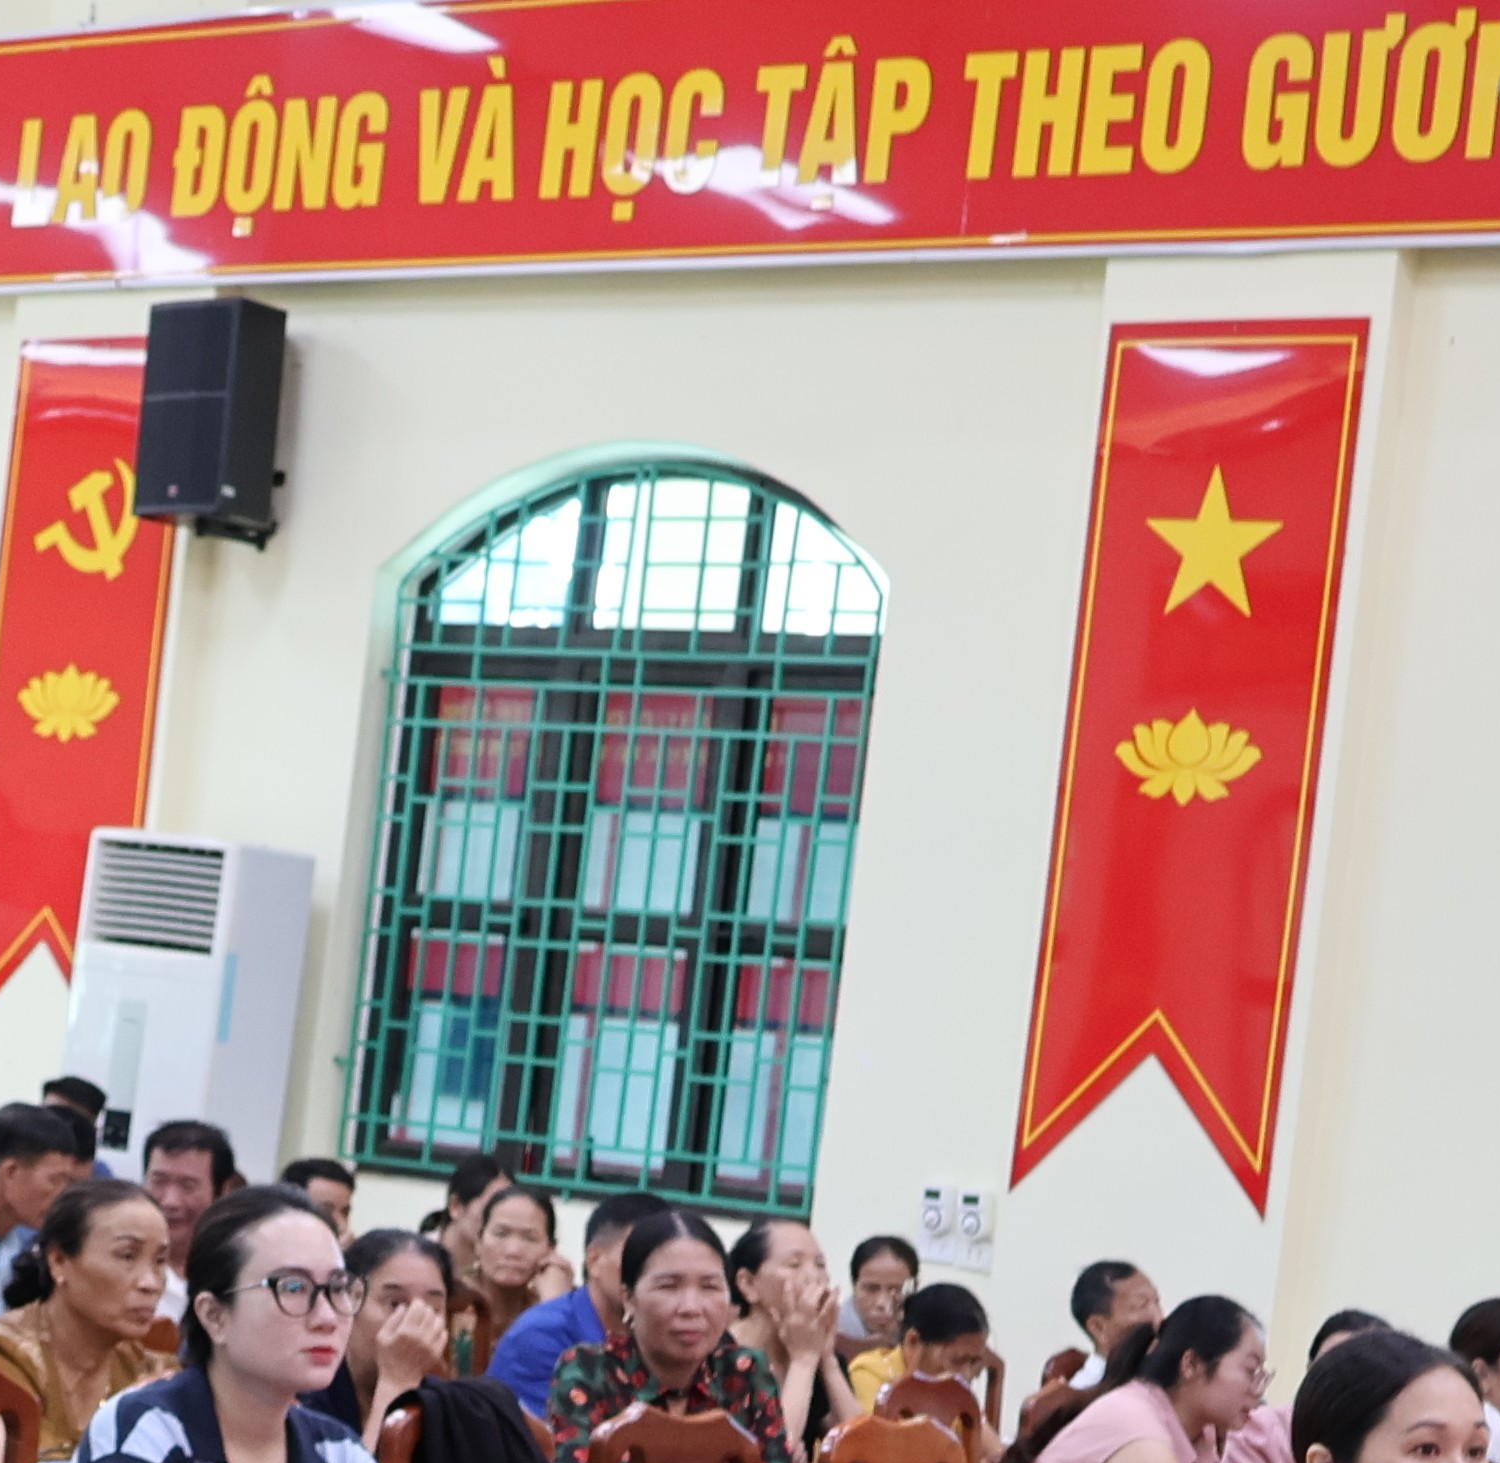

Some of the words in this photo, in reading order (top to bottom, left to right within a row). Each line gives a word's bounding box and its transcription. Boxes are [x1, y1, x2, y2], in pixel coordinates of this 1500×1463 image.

[10, 108, 151, 228] LAO
[170, 74, 388, 237] ĐỘNG
[419, 56, 514, 204] VÀ
[539, 67, 724, 222] HỌC
[756, 35, 932, 211] TẬP
[964, 37, 1211, 180] THEO
